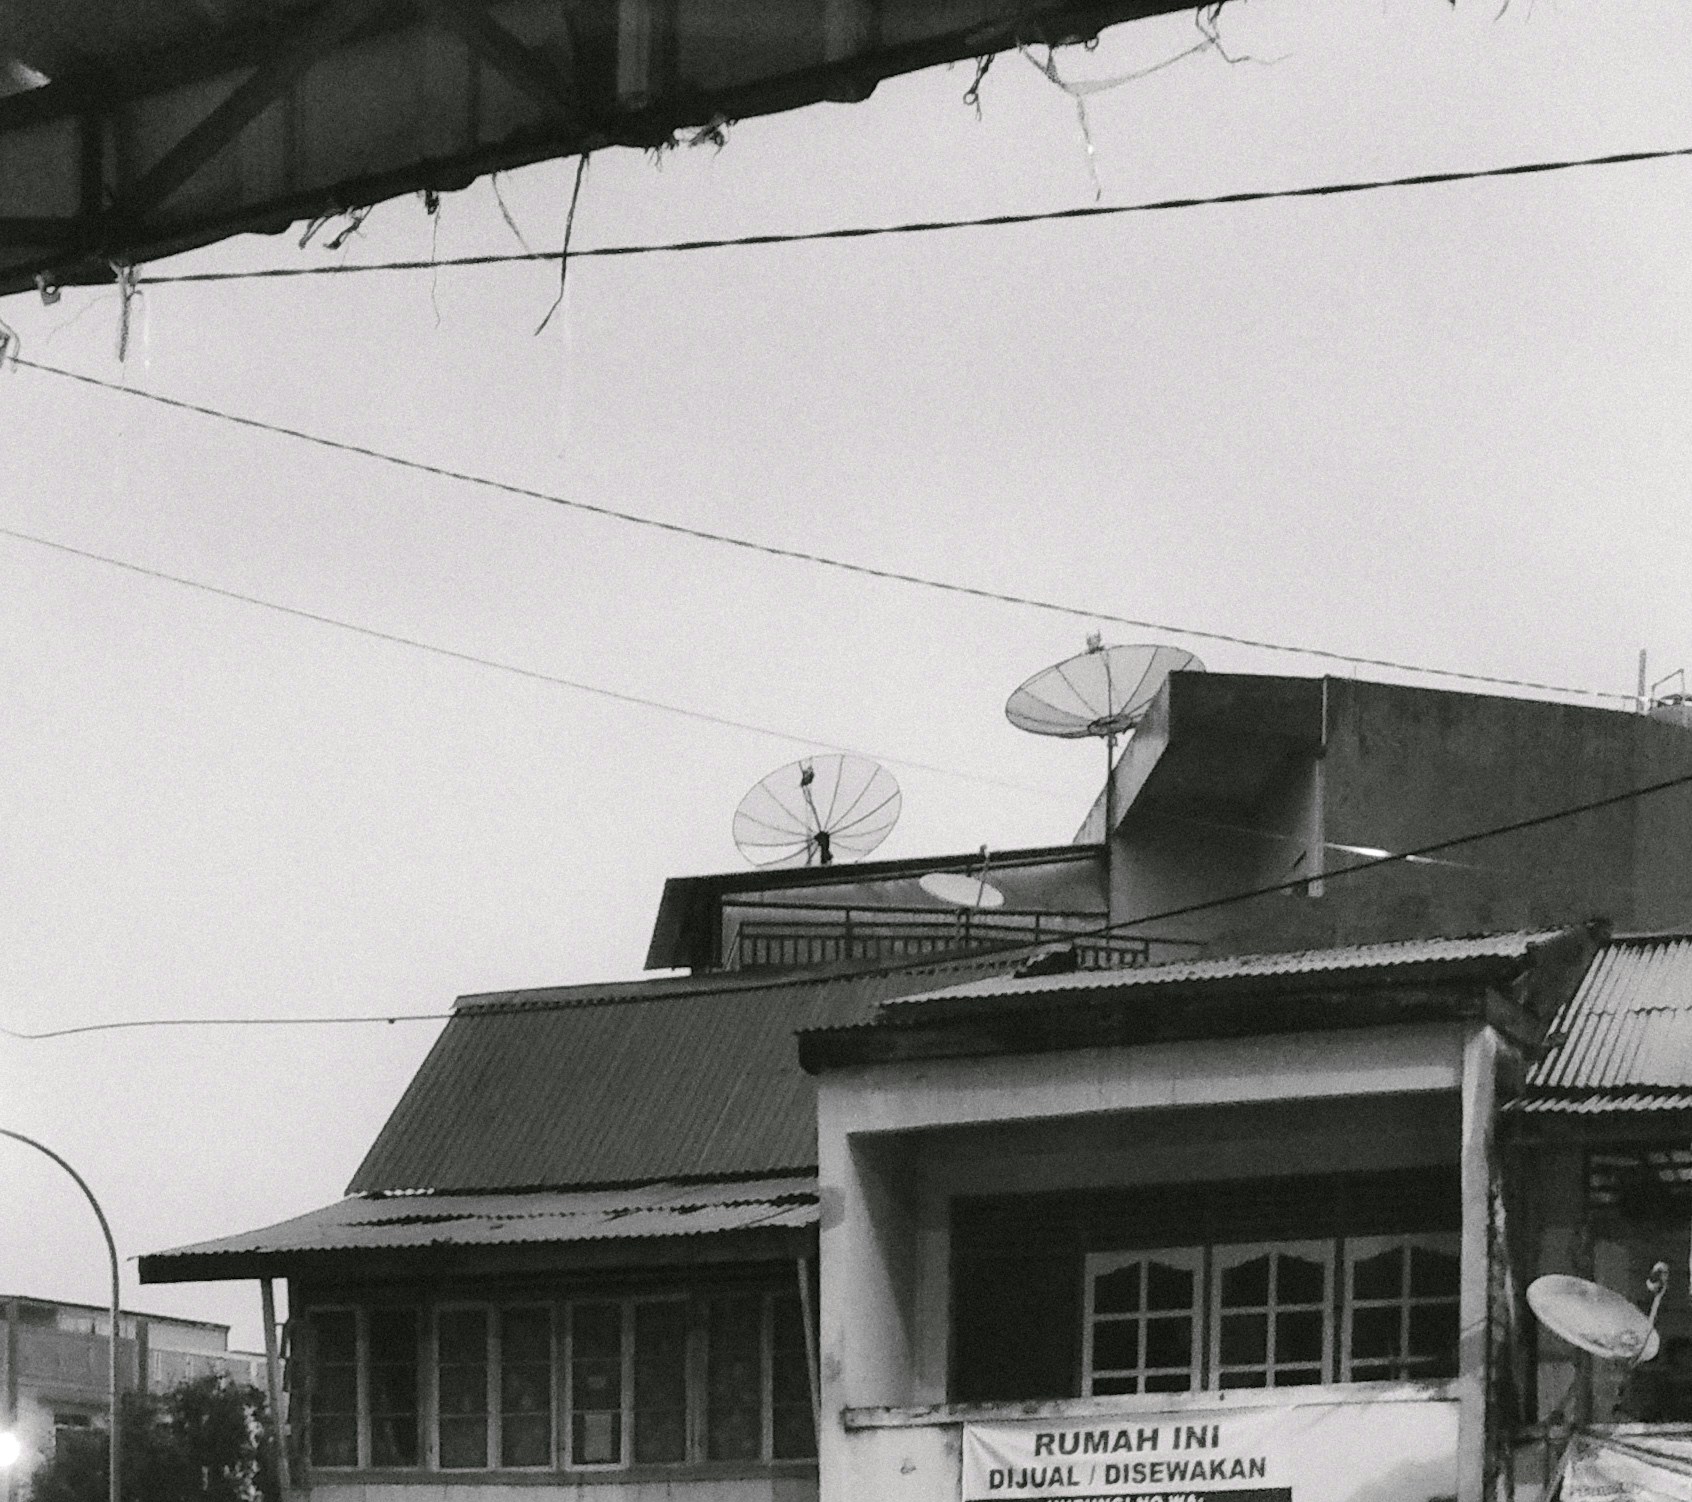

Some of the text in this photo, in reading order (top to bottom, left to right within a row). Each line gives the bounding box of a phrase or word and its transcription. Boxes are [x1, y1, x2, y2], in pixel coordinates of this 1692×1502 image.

[1034, 1424, 1219, 1457] RUMAH INI
[989, 1456, 1266, 1490] DIJUAL / DISEWAKAN
